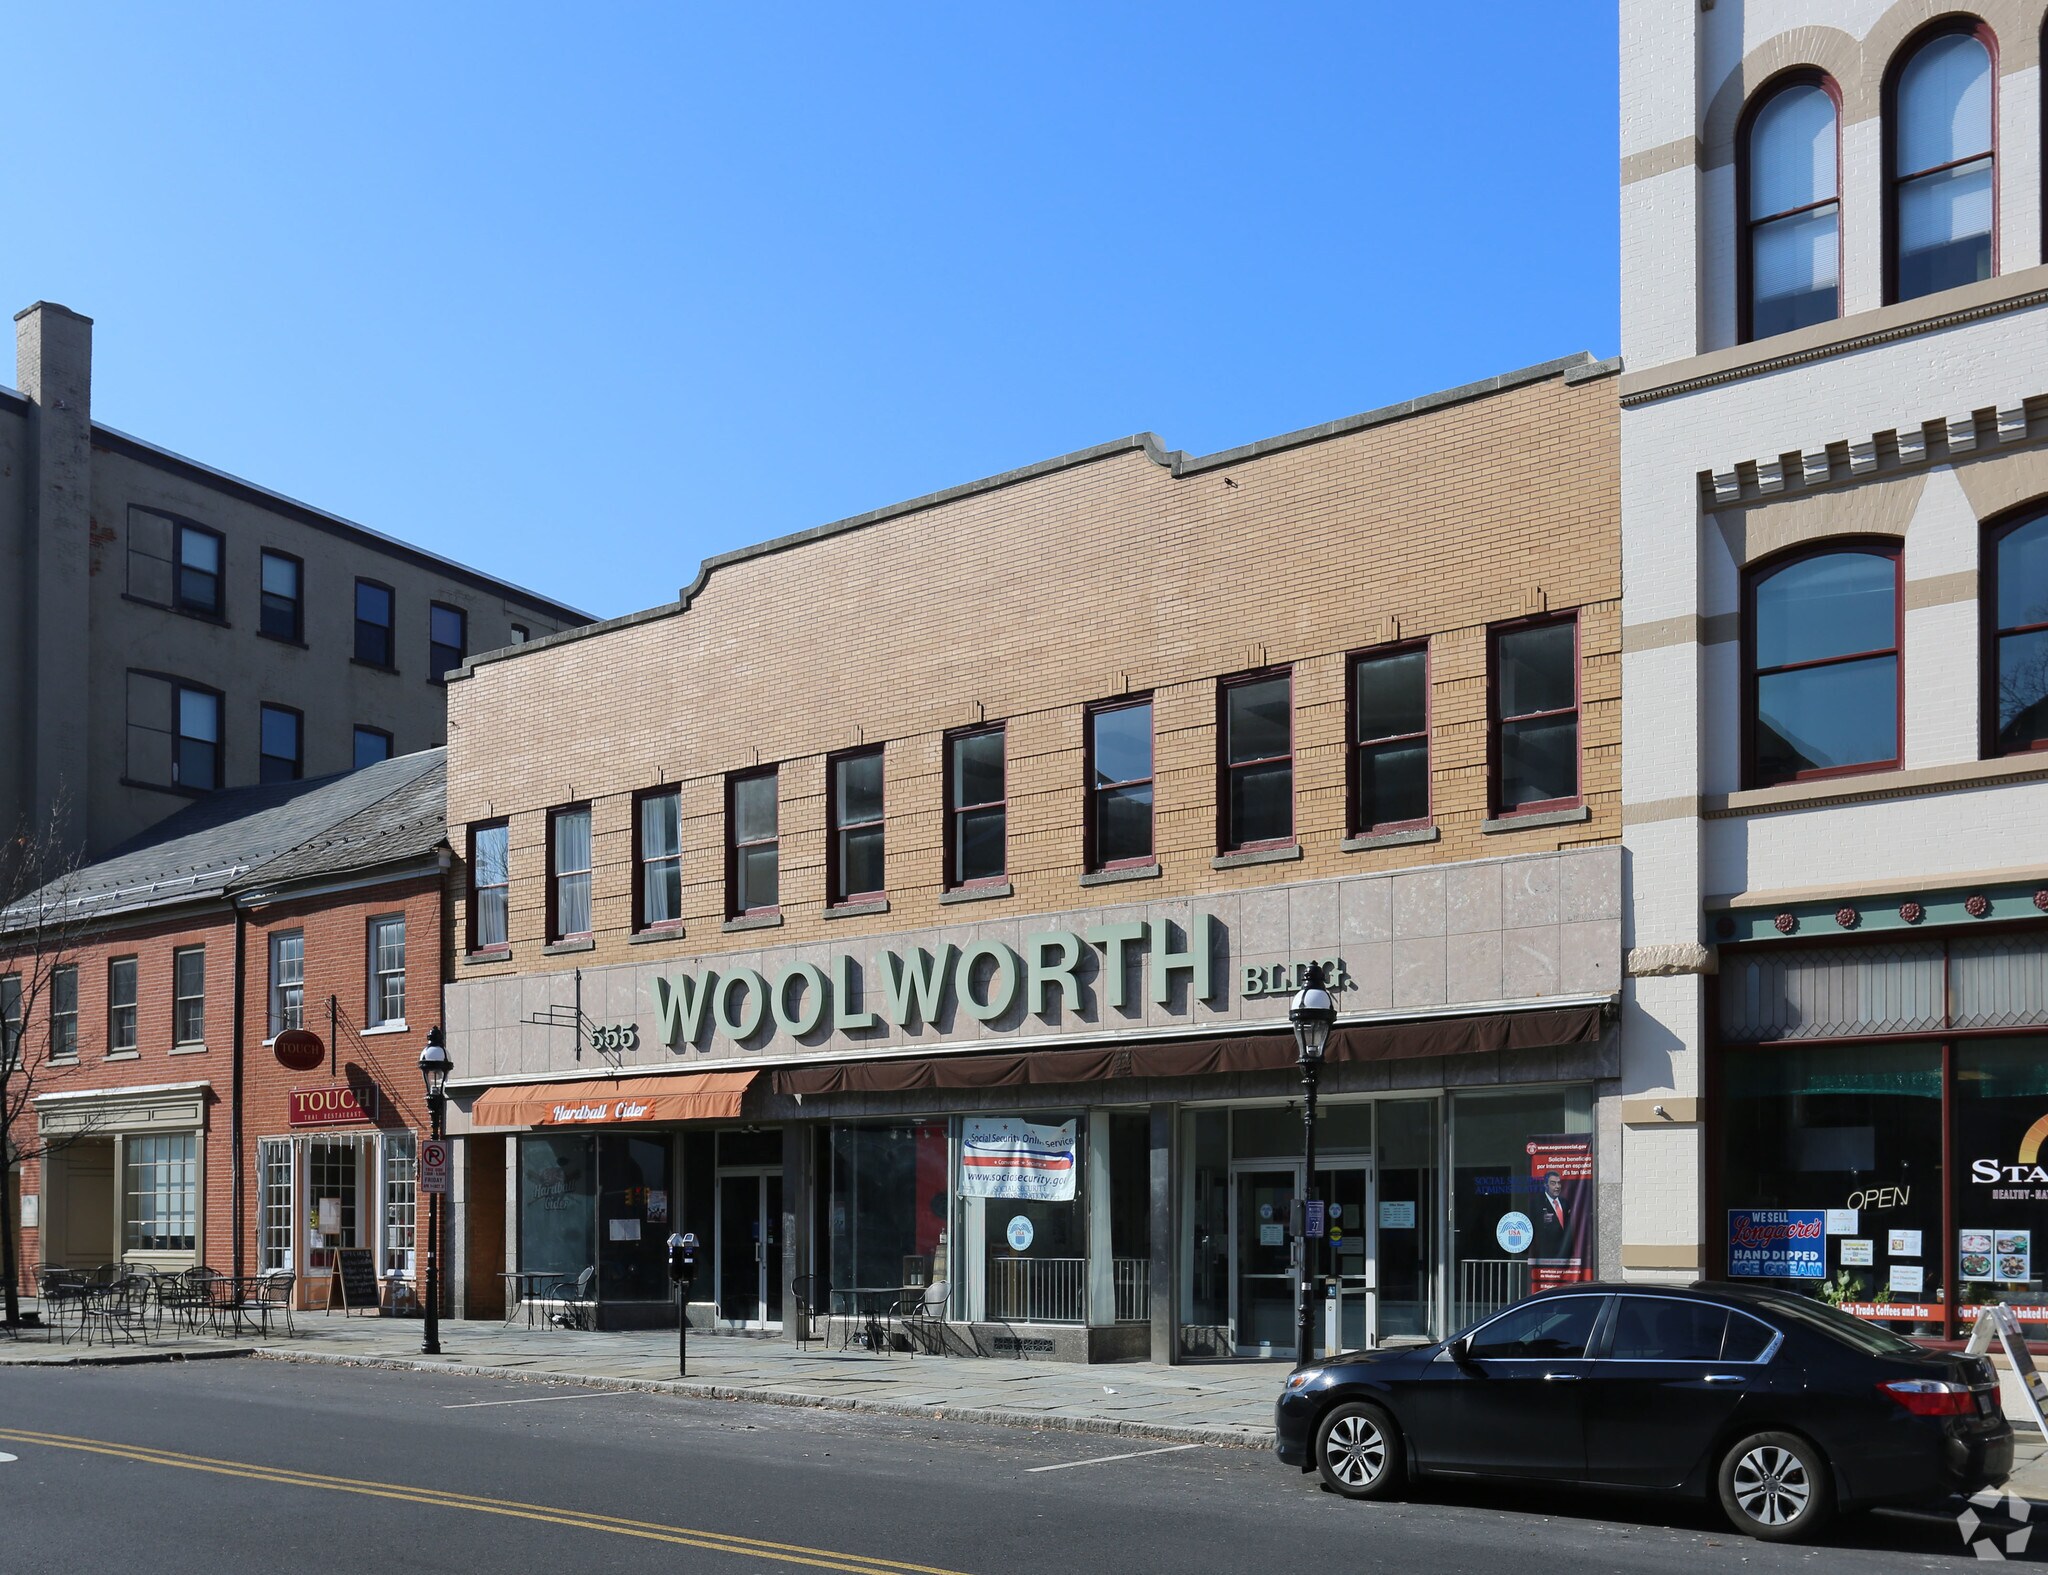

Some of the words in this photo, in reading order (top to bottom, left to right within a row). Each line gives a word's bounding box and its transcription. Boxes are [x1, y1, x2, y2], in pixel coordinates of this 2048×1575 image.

[650, 914, 1216, 1045] WOOLWORTH
[591, 1022, 635, 1049] 555
[281, 1042, 320, 1055] TOUCH
[294, 1088, 371, 1112] TOUCH
[552, 1105, 608, 1122] Hardball
[614, 1101, 648, 1118] Cider
[971, 1133, 991, 1143] Social
[1847, 1186, 1911, 1210] OPEN
[1752, 1212, 1767, 1223] WE
[1767, 1212, 1789, 1223] SELL
[1311, 1221, 1320, 1231] 27
[1731, 1215, 1823, 1248] Longacre's
[1733, 1250, 1770, 1260] HAND
[1772, 1250, 1819, 1261] DIPPED
[1731, 1260, 1760, 1276] ICE
[1763, 1260, 1823, 1277] CREAM
[1841, 1304, 1854, 1314] Fair
[1855, 1304, 1875, 1315] Trade
[1875, 1304, 1901, 1316] Coffees
[1901, 1305, 1915, 1317] and
[1915, 1305, 1929, 1317] Tea
[1958, 1306, 1971, 1318] Our
[2017, 1306, 2041, 1319] baked
